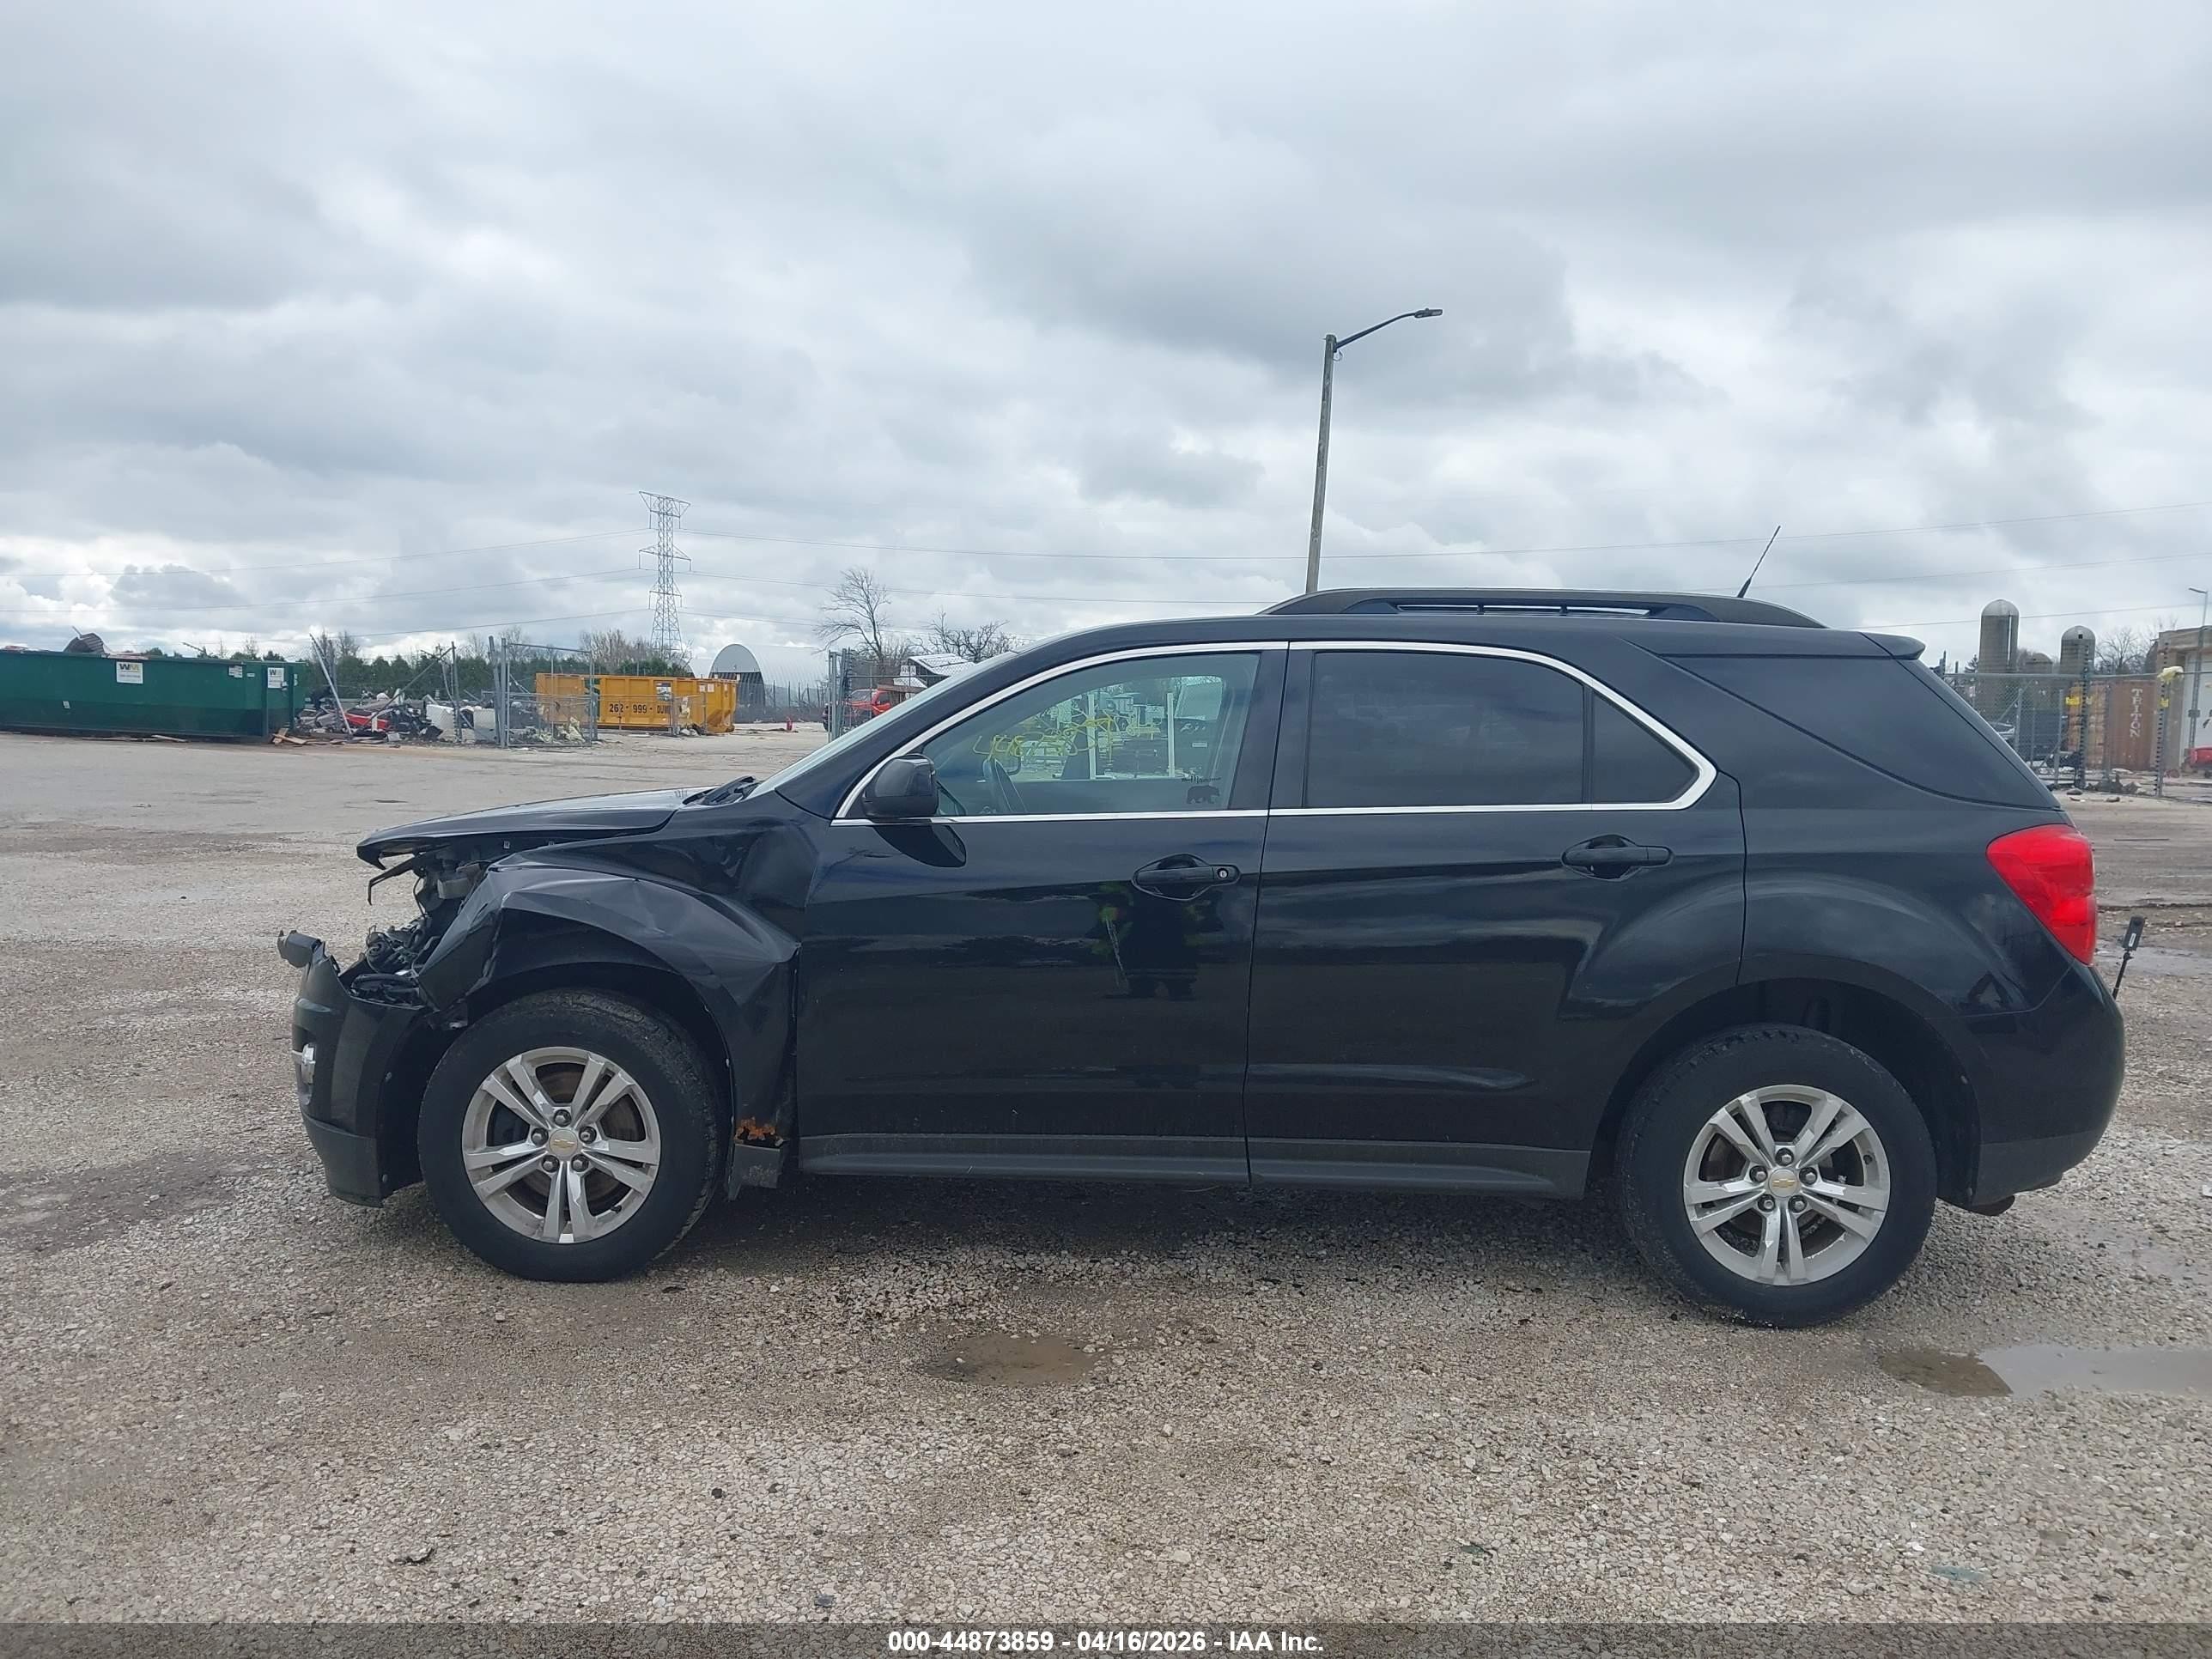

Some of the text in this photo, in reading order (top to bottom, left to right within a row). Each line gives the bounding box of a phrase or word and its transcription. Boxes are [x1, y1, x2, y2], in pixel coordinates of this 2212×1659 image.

[609, 703, 624, 713] 262
[632, 704, 647, 714] 999
[2130, 689, 2143, 738] TRITON
